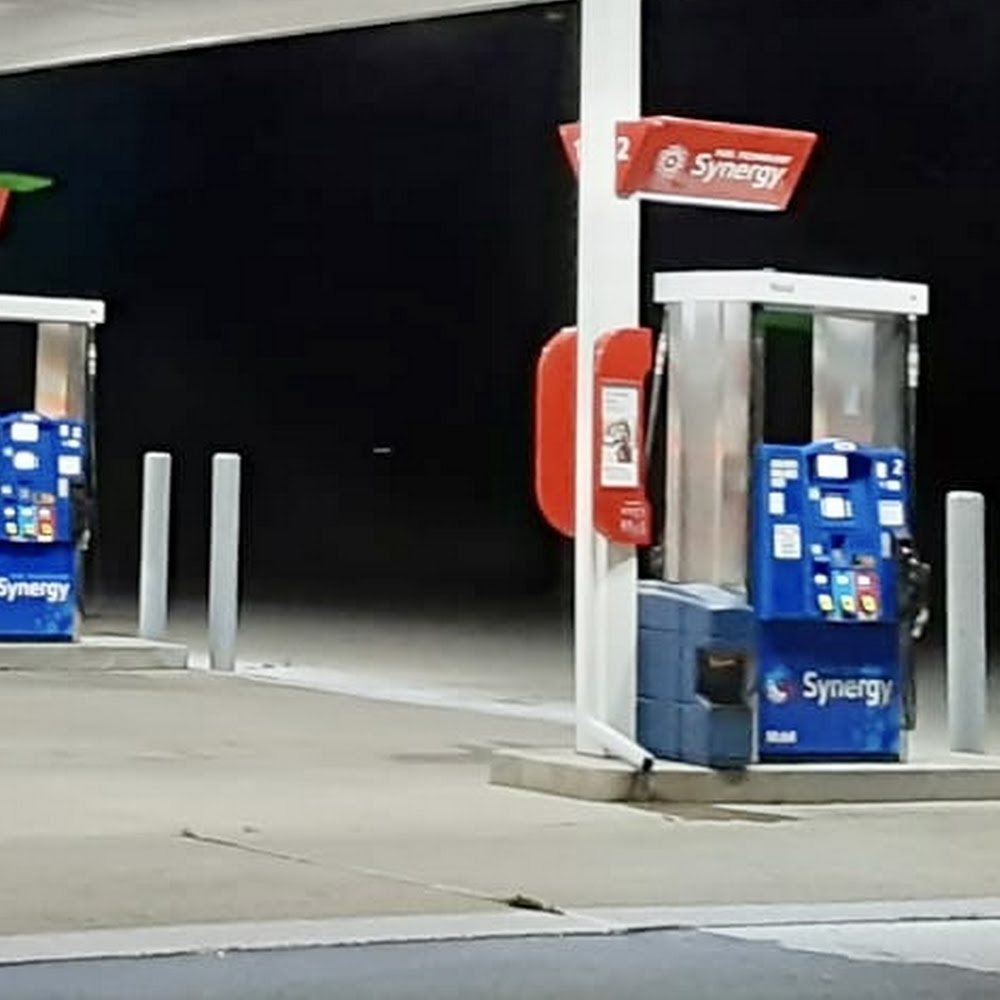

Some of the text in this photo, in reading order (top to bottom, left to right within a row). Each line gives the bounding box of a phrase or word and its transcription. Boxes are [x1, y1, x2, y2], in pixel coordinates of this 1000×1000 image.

[616, 136, 631, 161] 2
[690, 153, 789, 190] Synergy
[802, 670, 893, 707] Synergy
